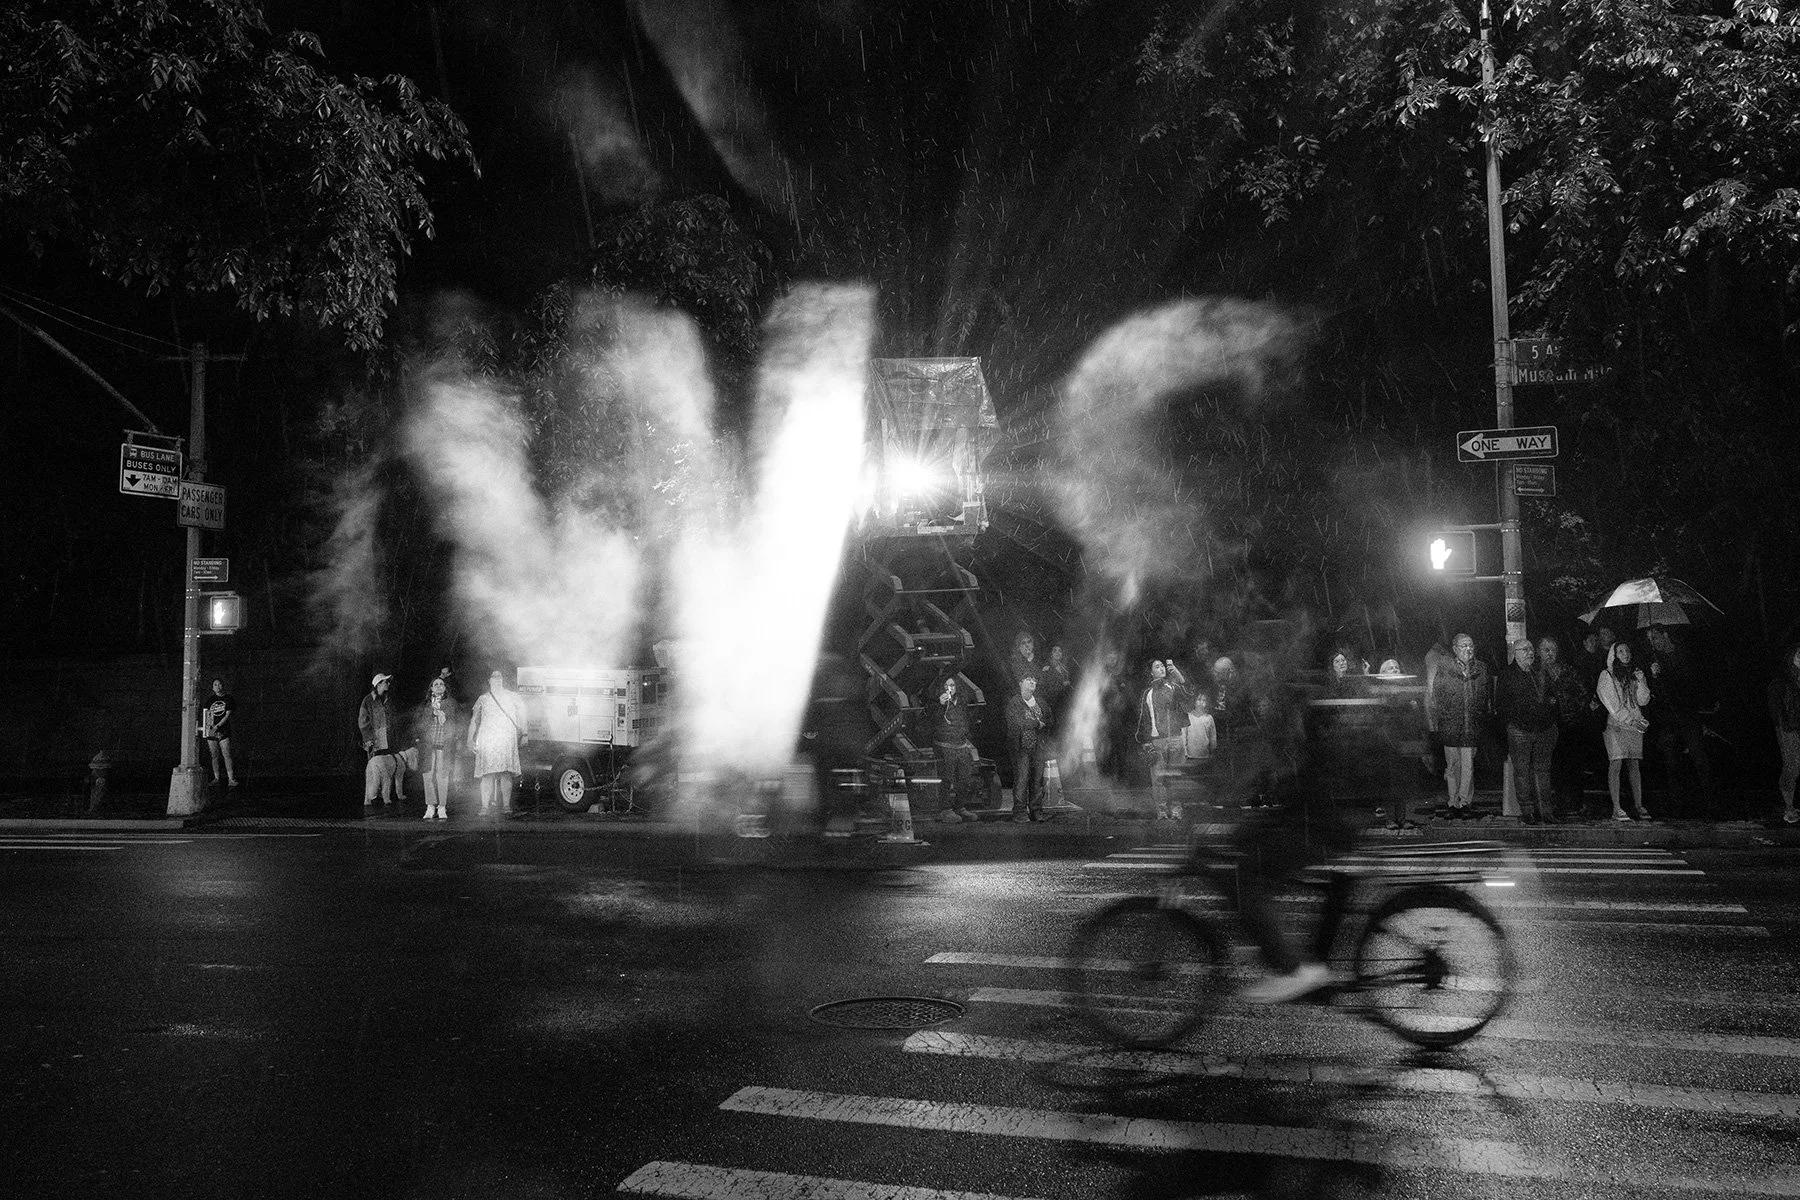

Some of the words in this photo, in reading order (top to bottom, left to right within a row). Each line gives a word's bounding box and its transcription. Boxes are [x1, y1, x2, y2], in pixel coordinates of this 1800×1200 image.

[1531, 345, 1539, 360] 5
[1471, 439, 1500, 452] ONE
[1516, 436, 1547, 449] WAY
[140, 450, 155, 460] BUS
[156, 452, 175, 462] LANE
[126, 460, 153, 471] BUSES
[155, 463, 177, 473] ONLY
[142, 473, 156, 481] 7AM
[143, 483, 158, 492] MON
[182, 487, 224, 505] PASSENGER
[181, 505, 201, 519] CARS
[204, 507, 223, 522] ONLY
